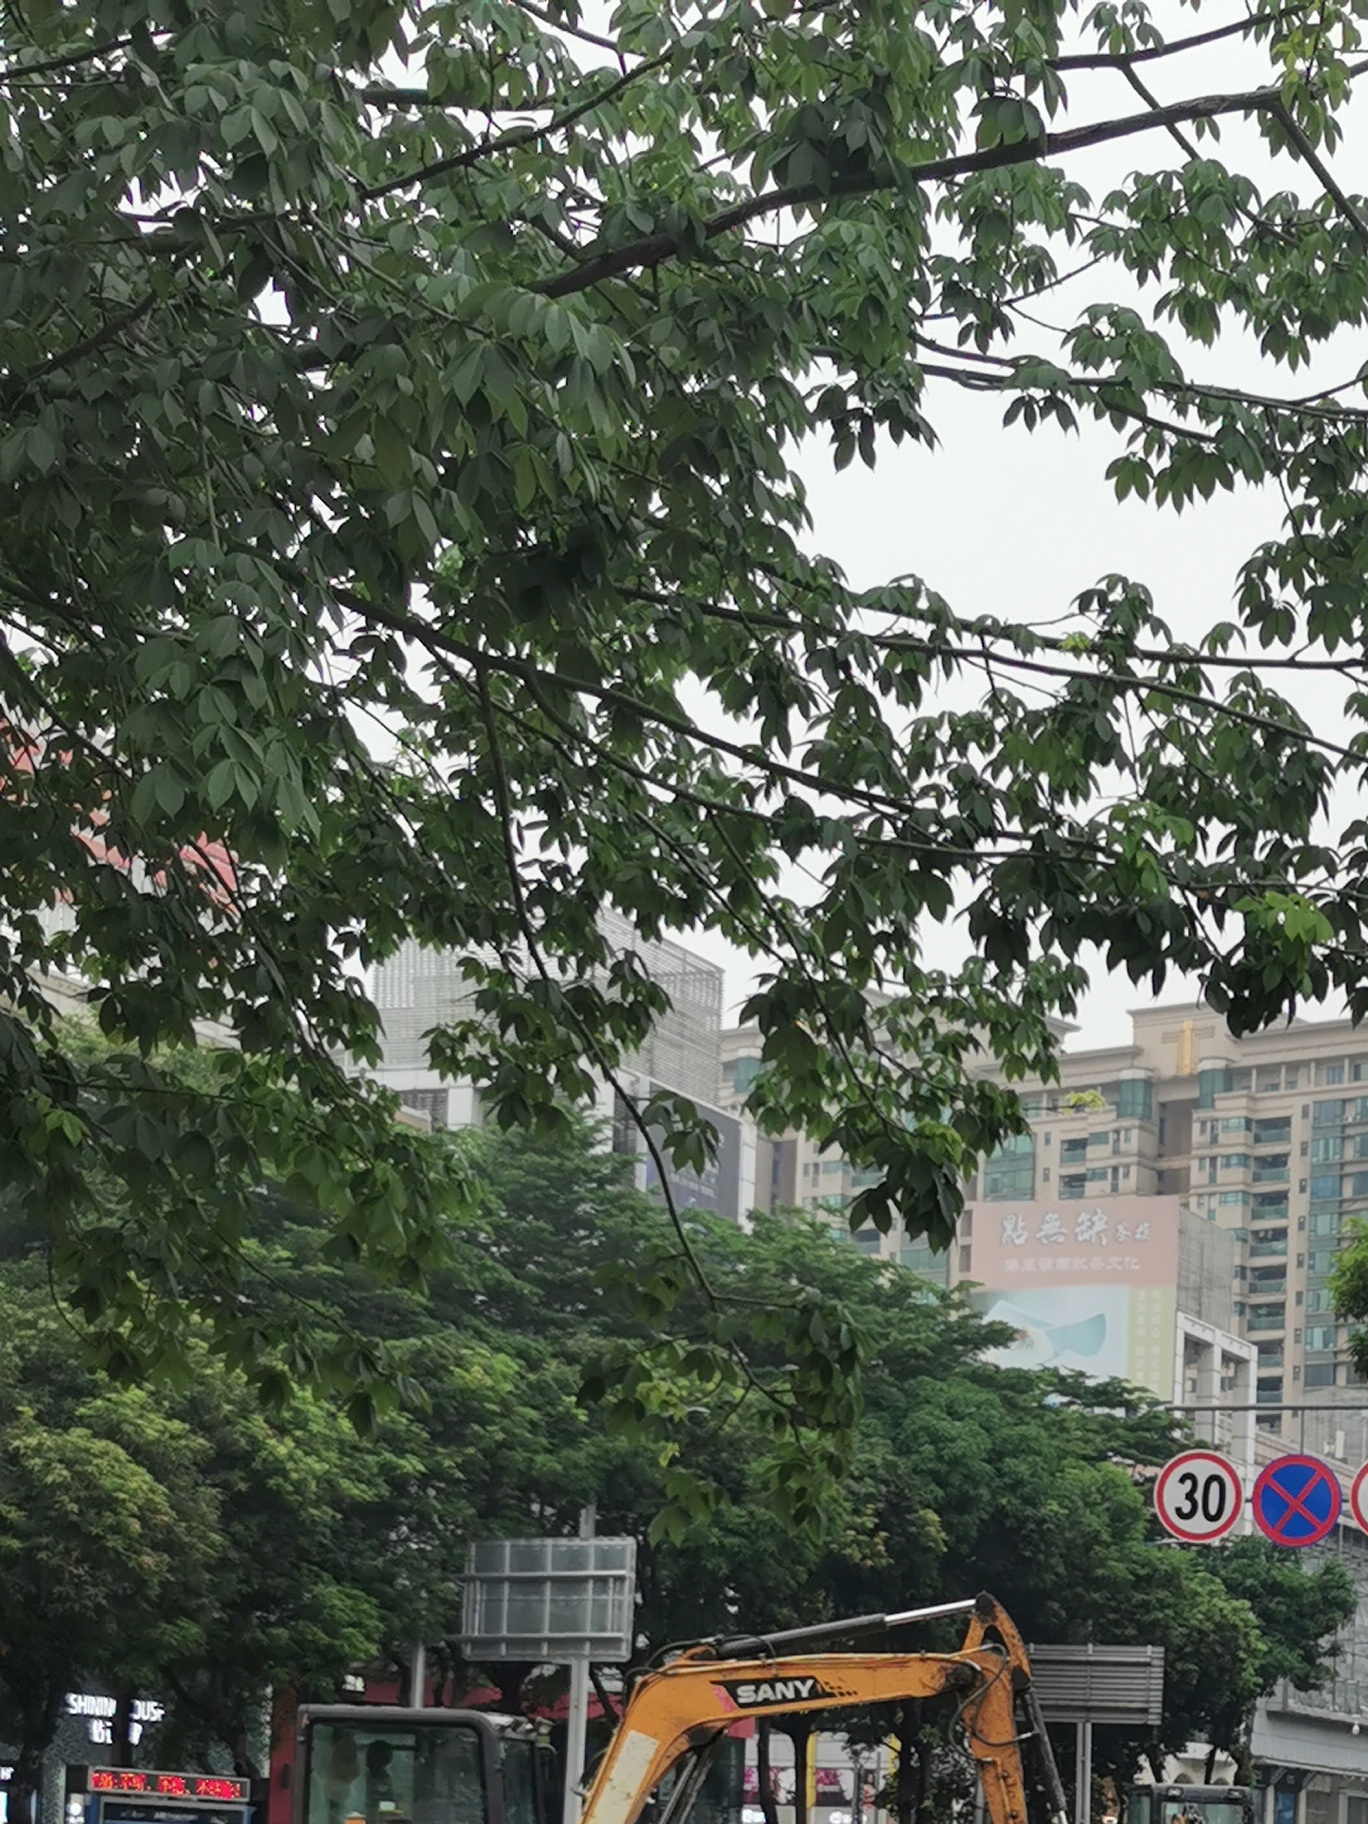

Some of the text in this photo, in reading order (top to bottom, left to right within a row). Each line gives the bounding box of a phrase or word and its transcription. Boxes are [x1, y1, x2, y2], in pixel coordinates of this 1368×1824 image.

[1174, 1472, 1226, 1522] 30
[736, 1679, 815, 1703] SANY
[65, 1692, 117, 1717] SHININ
